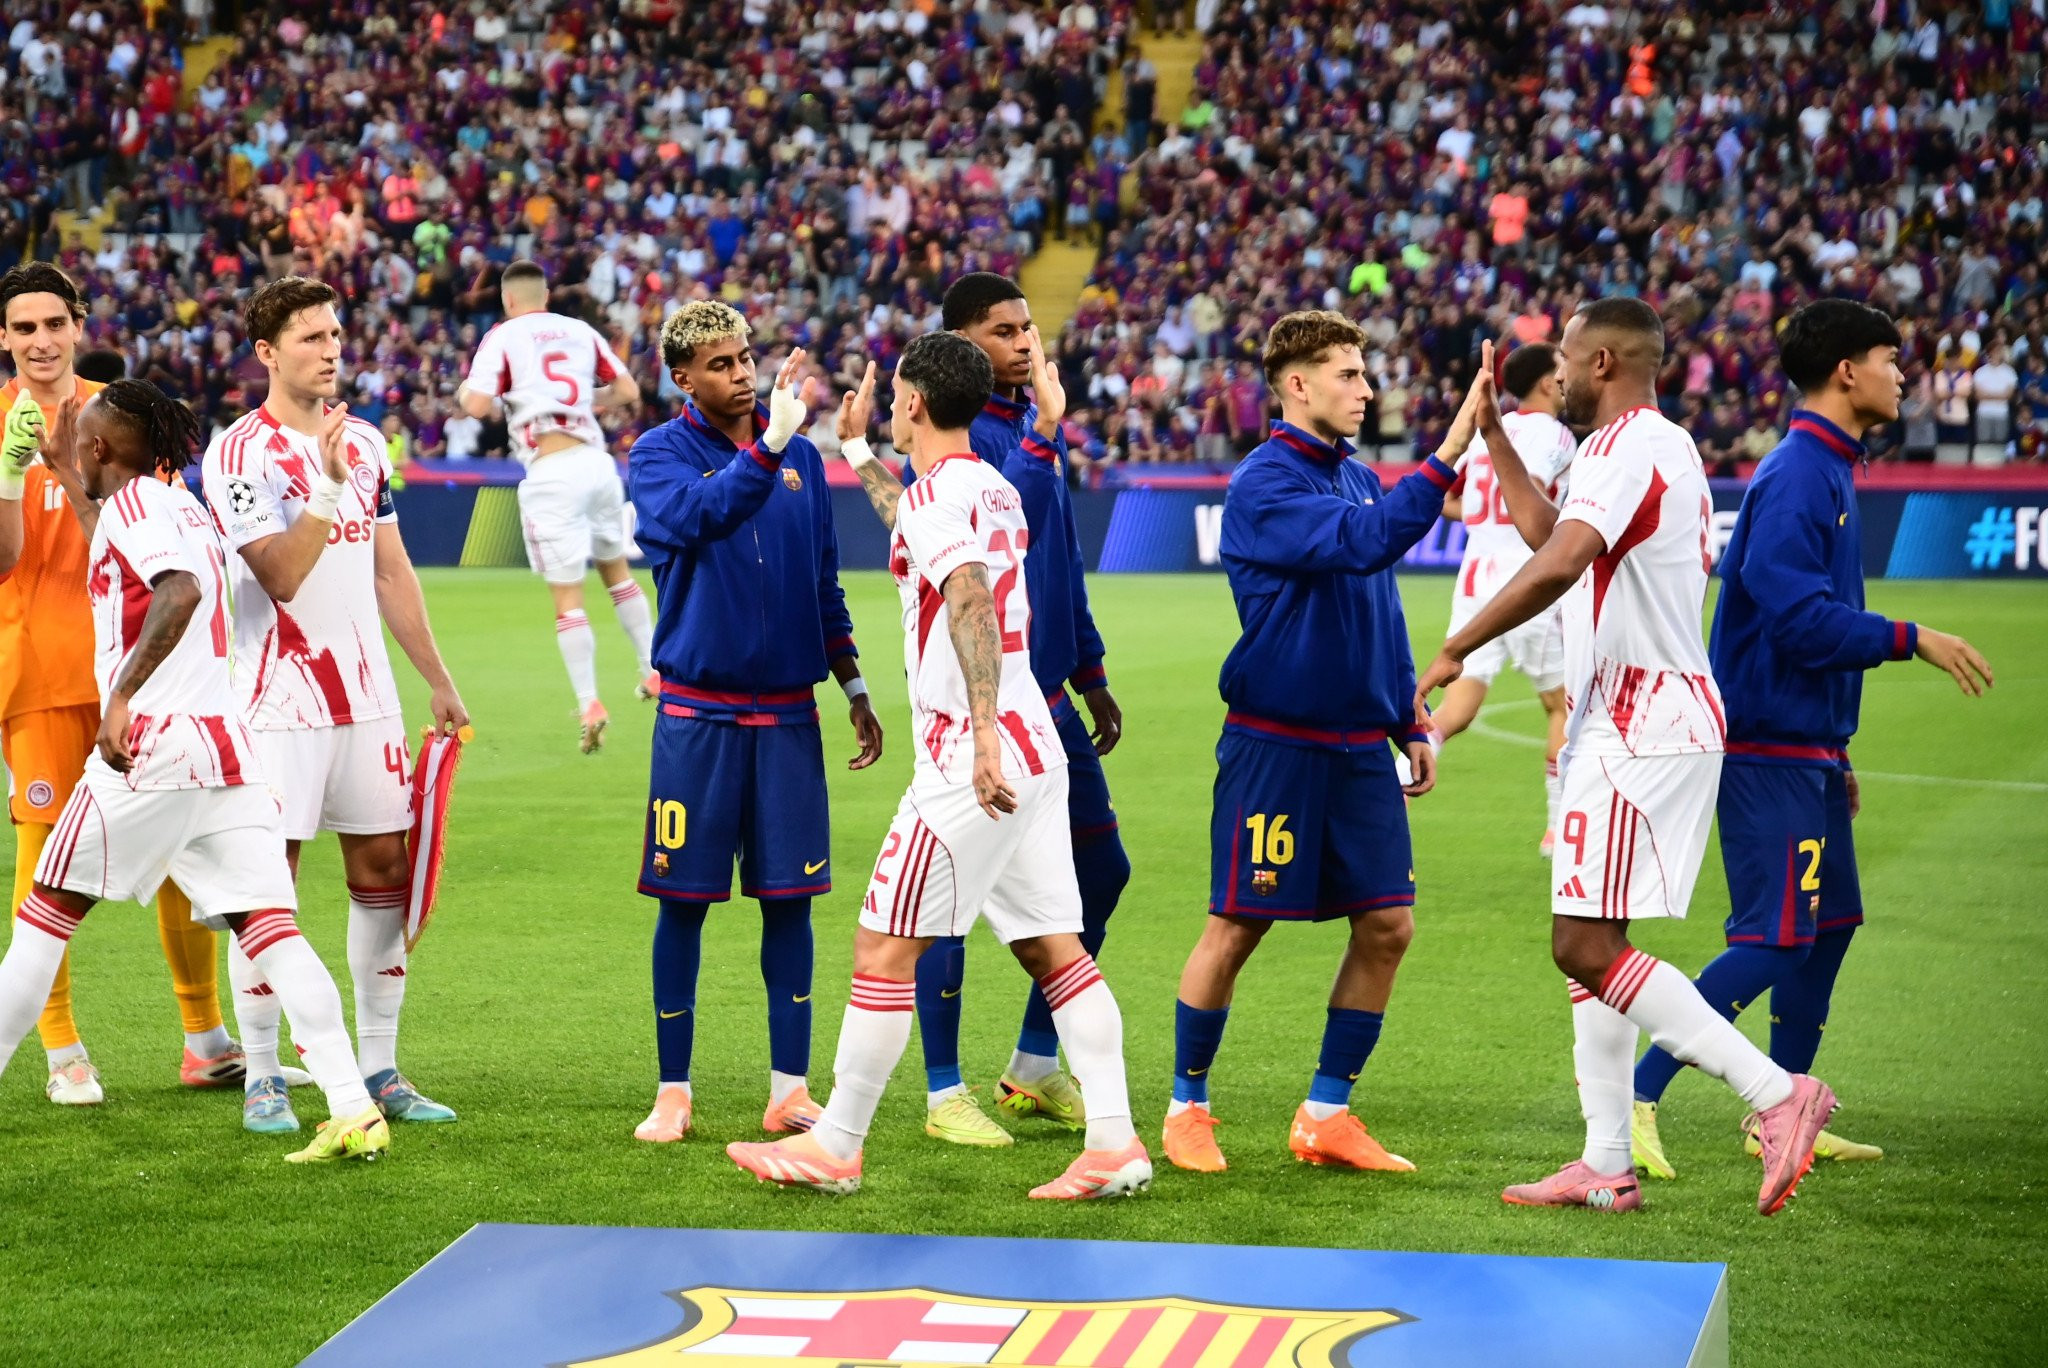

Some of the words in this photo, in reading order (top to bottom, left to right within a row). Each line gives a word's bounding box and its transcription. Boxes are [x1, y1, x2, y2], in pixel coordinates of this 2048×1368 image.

[541, 350, 579, 407] 5
[653, 798, 687, 850] 10
[1246, 813, 1294, 865] 16
[1563, 810, 1588, 866] 9
